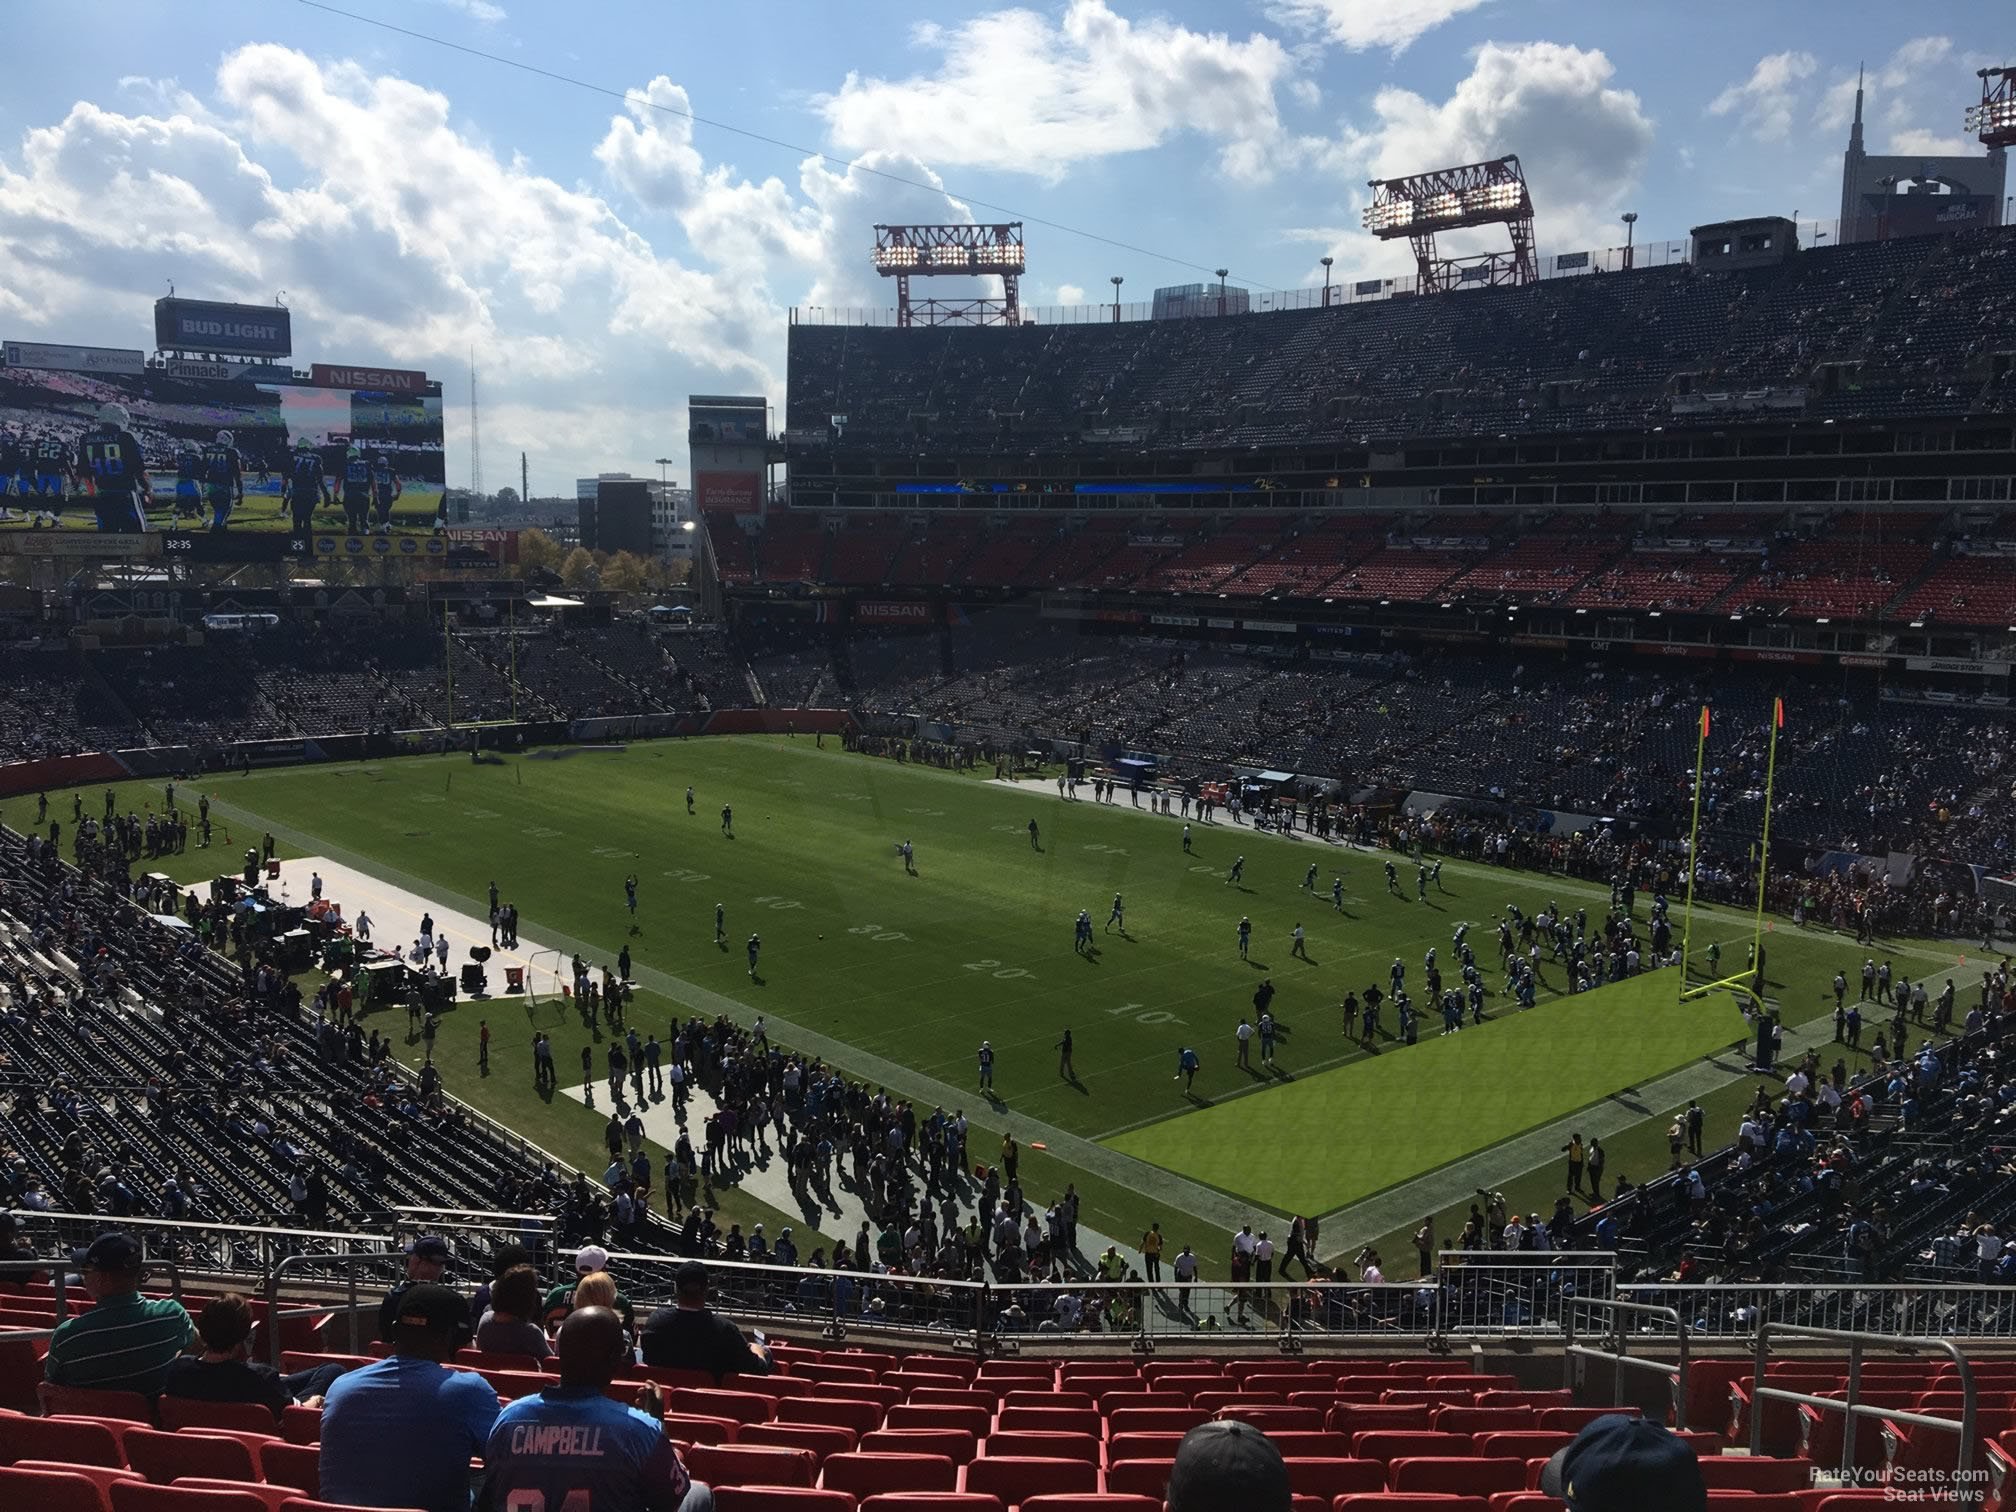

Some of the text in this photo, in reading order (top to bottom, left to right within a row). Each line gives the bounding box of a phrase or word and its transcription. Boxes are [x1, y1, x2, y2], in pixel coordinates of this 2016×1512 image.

[182, 319, 279, 340] BUD LIGHT
[169, 361, 229, 379] Pinnacle
[329, 370, 411, 388] NISSAN
[446, 530, 507, 541] NISSAN
[166, 540, 191, 550] 32:35
[292, 541, 304, 550] 25
[860, 605, 926, 616] NISSAN
[1316, 626, 1344, 635] UNITED
[1591, 641, 1610, 650] CMT
[1757, 652, 1795, 661] NISSAN
[1931, 662, 1984, 672] BRIDGESTONE
[663, 868, 711, 882] 50
[752, 896, 801, 910] 40
[847, 925, 905, 942] 30
[962, 959, 1029, 979] 20
[1104, 1002, 1175, 1024] 10
[511, 1425, 604, 1456] CAMPBELL
